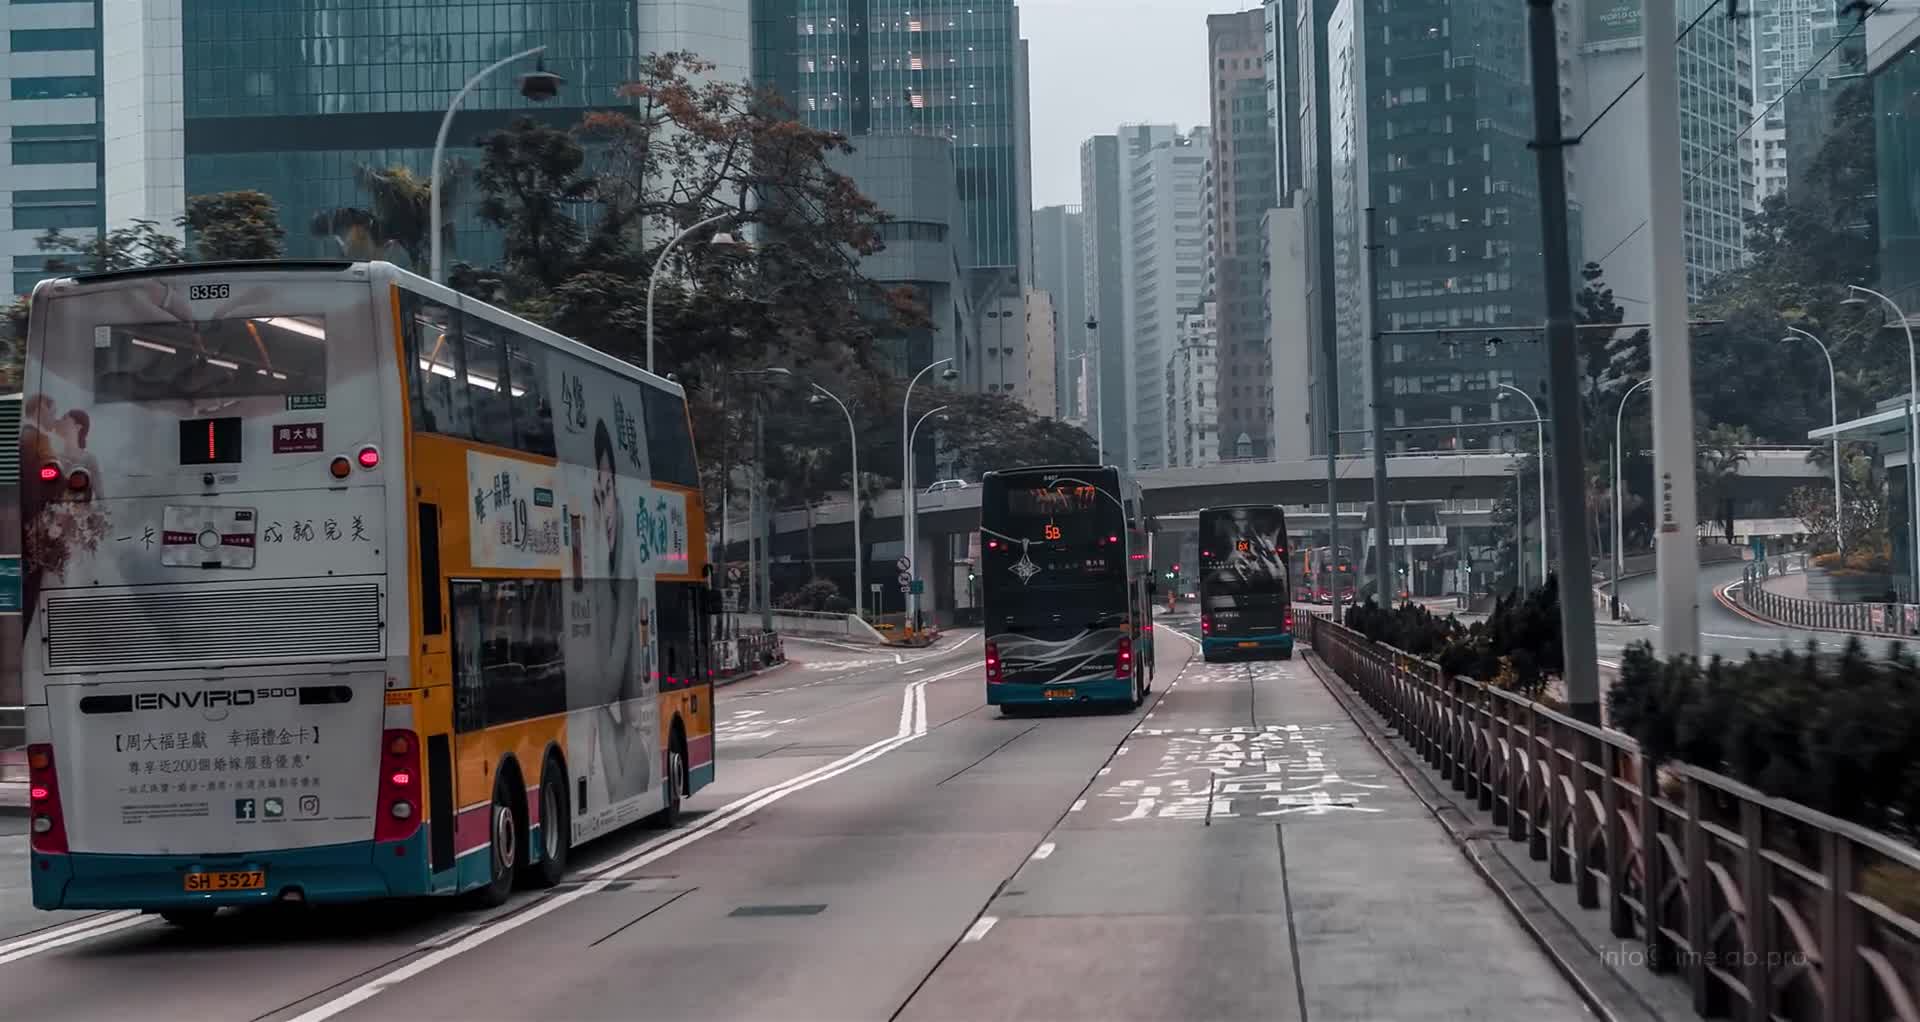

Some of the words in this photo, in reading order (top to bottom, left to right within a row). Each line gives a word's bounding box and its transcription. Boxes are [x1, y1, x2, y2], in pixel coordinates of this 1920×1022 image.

[191, 285, 229, 299] 8356
[208, 421, 215, 459] 1
[116, 526, 156, 551] 一卡
[263, 515, 371, 544] 成就完美
[1045, 524, 1061, 539] 5B
[188, 874, 211, 889] SH
[217, 872, 262, 888] 5527
